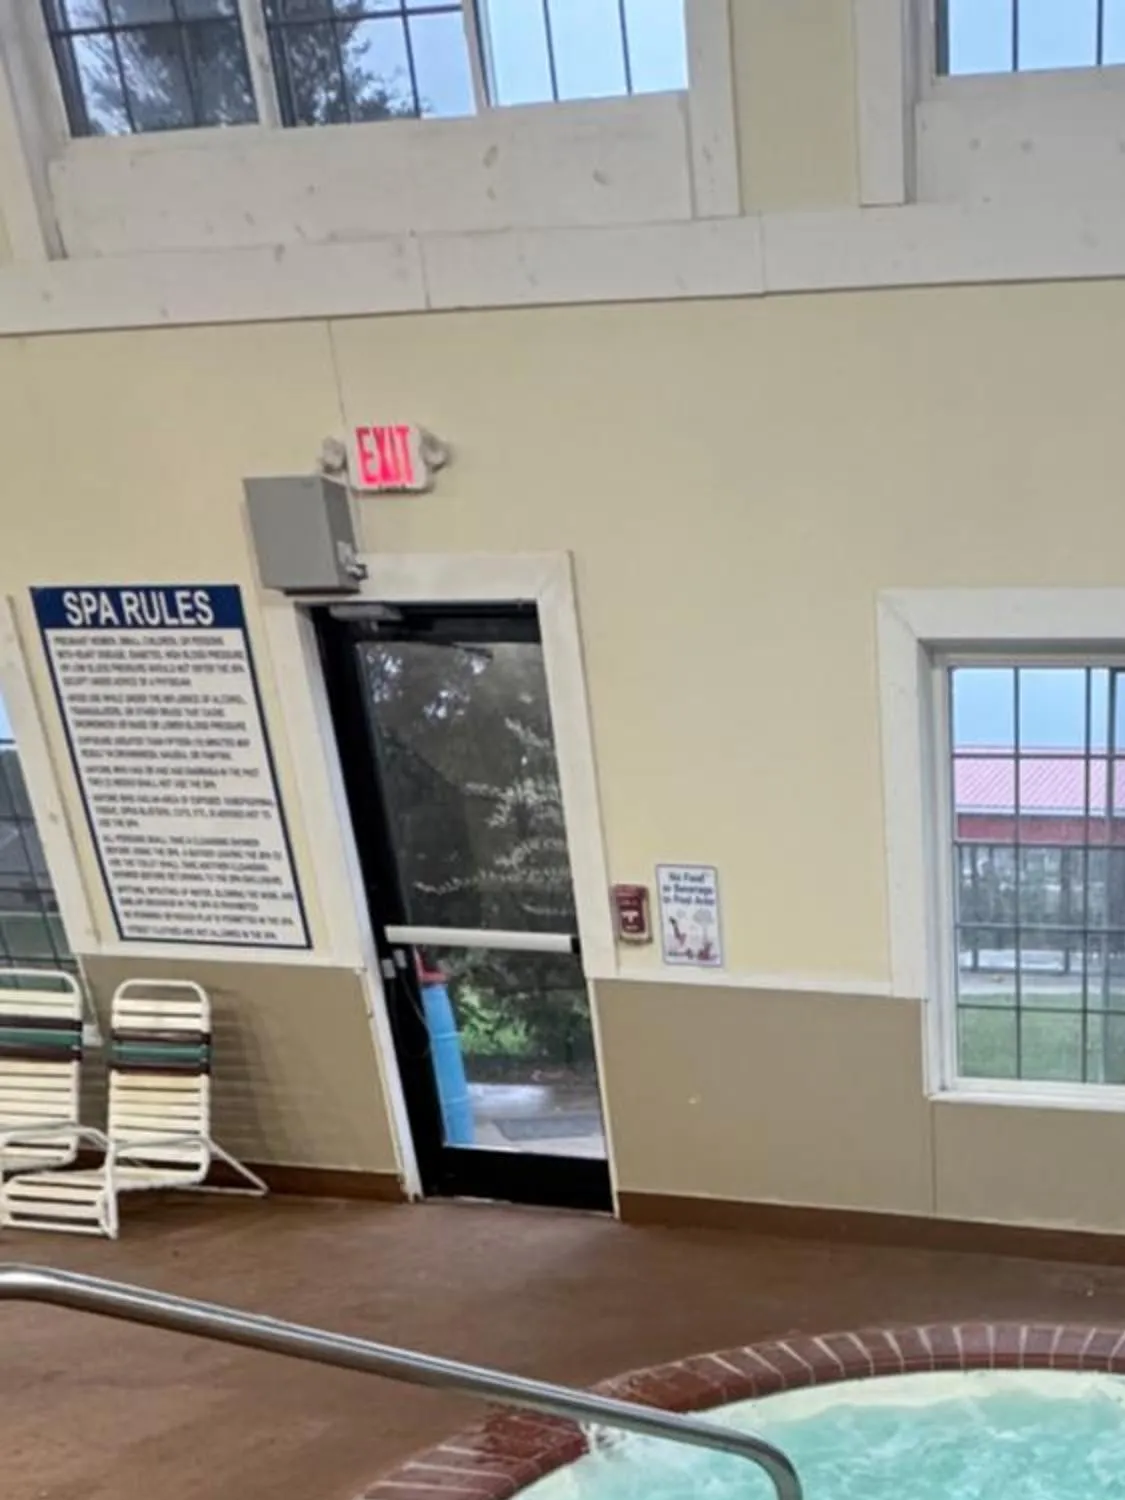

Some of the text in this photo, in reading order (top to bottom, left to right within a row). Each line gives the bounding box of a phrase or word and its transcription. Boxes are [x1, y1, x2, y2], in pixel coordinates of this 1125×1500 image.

[355, 426, 415, 484] EXIT
[63, 590, 214, 626] SPA RULES
